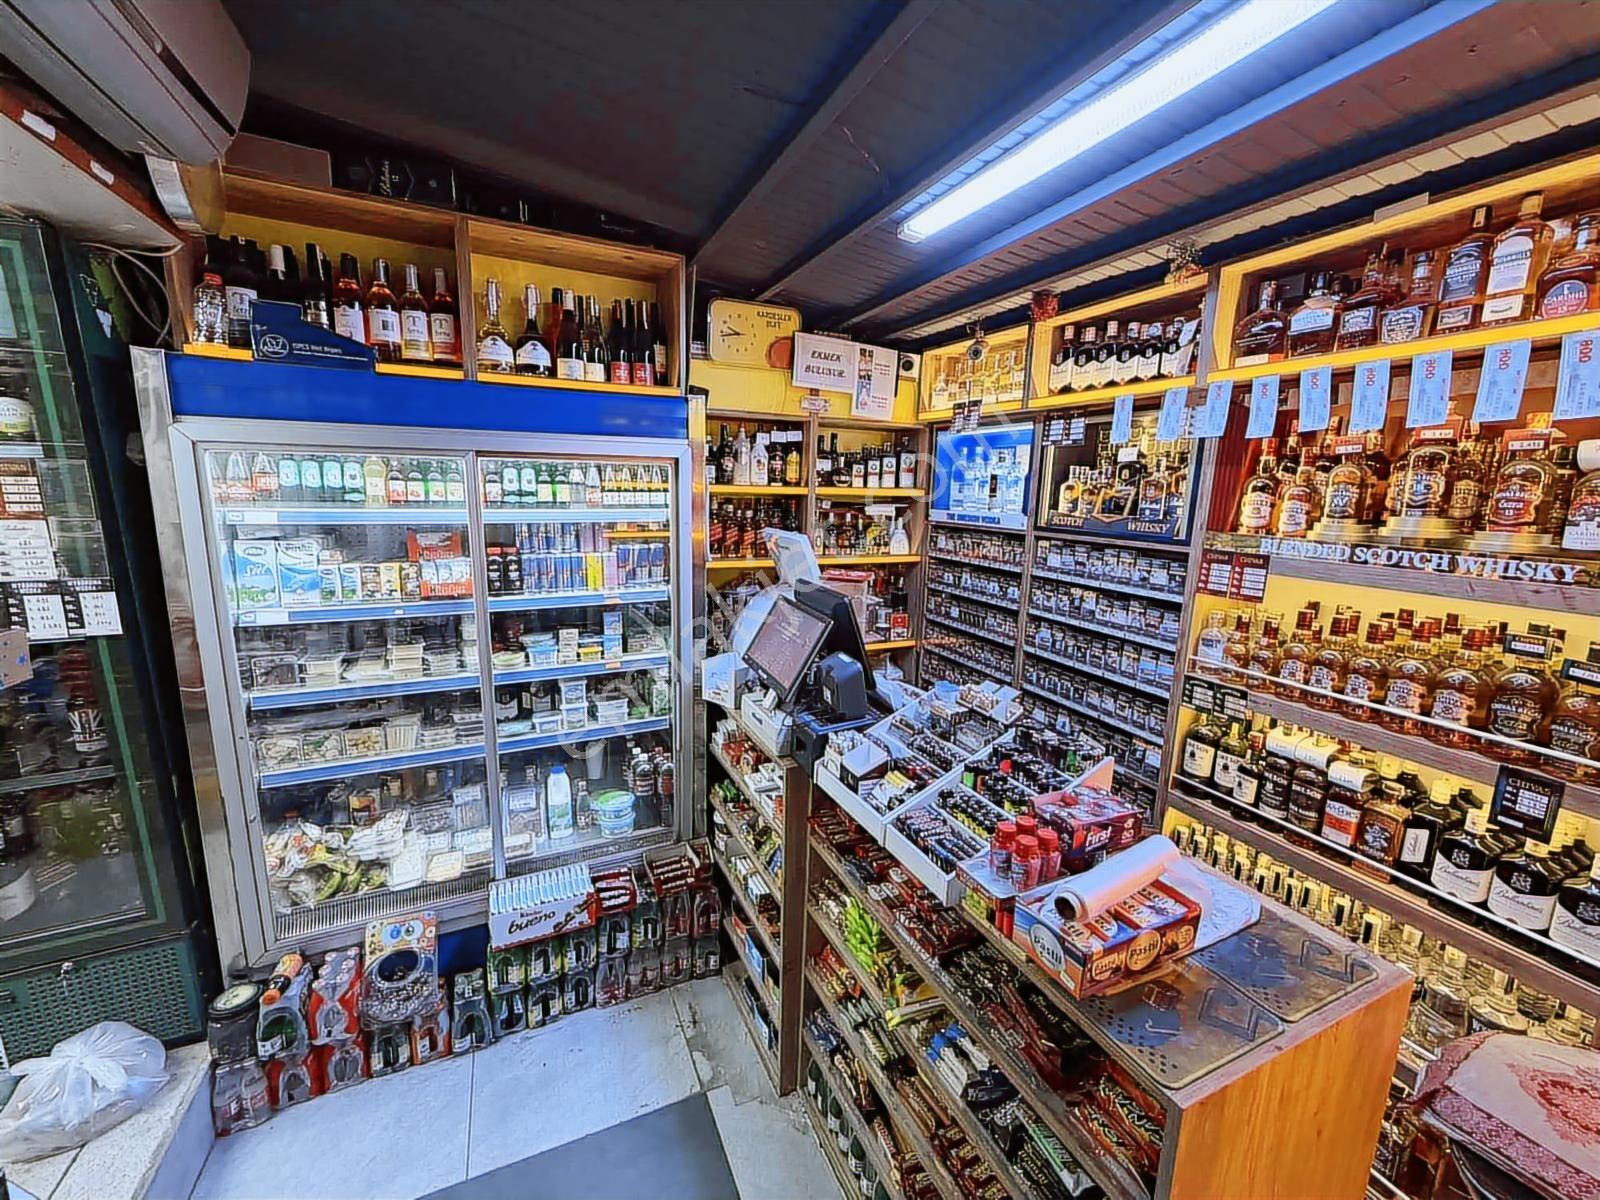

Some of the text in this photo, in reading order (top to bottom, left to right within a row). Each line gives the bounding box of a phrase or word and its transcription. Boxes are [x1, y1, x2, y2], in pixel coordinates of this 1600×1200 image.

[810, 349, 843, 363] EKMEK
[1578, 339, 1594, 364] 800
[1050, 516, 1171, 534] SCOTCH WHISKY
[1259, 537, 1585, 583] BLENDED SCOTCH WHISKY
[1508, 777, 1551, 794] CHIVAS
[1086, 826, 1112, 847] First
[508, 912, 556, 934] bueno
